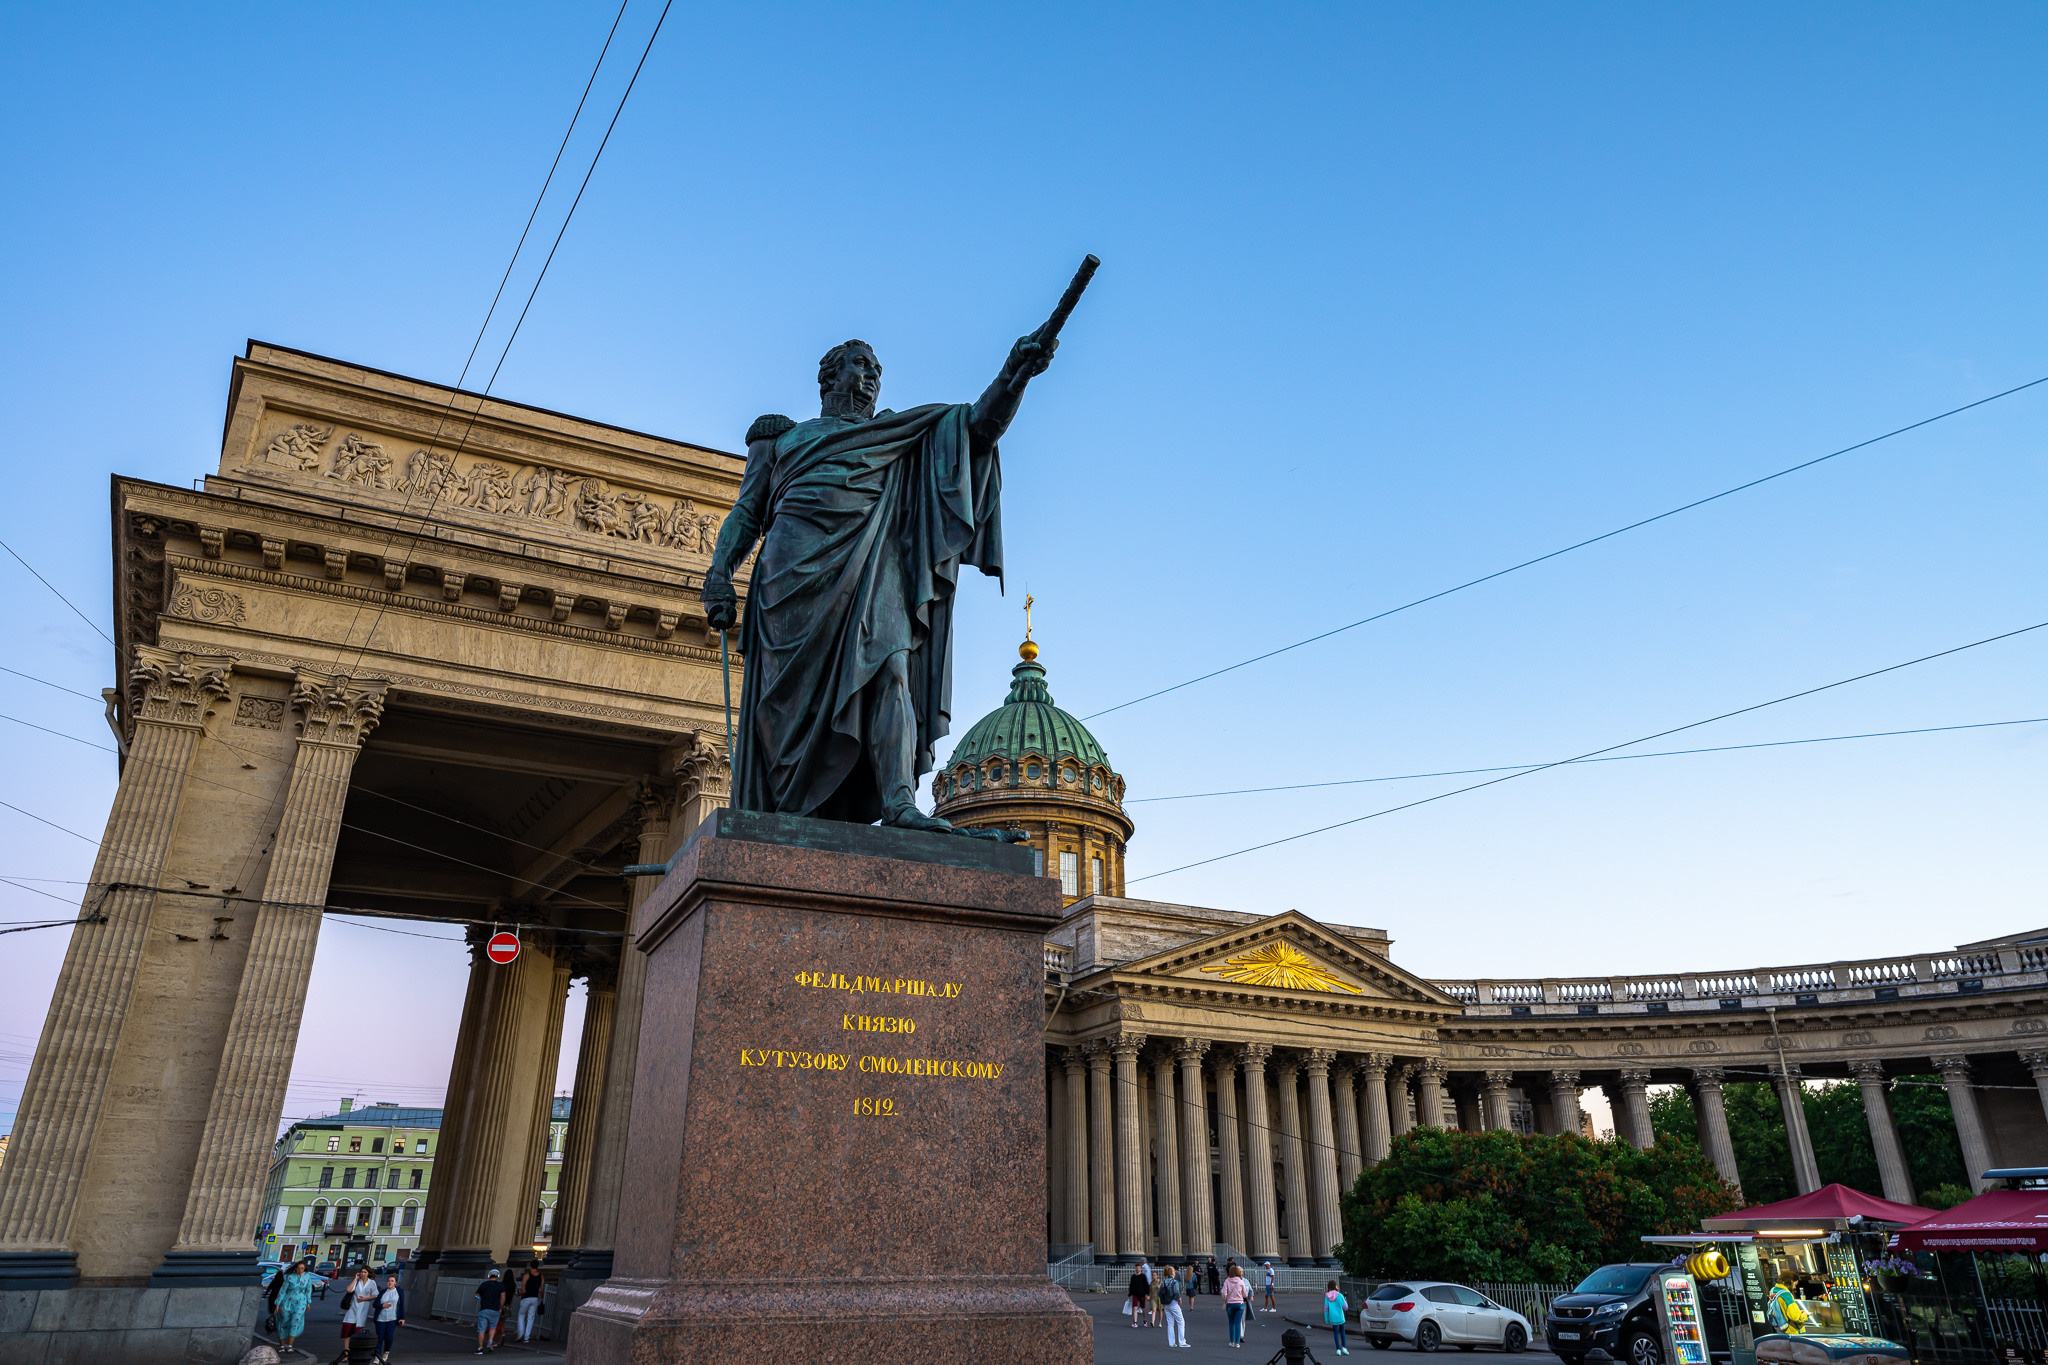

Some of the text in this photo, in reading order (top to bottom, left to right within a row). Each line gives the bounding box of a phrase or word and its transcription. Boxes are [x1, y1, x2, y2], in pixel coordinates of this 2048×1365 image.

[794, 970, 964, 999] ФЕЛЬДМАРШАЛУ
[842, 1013, 916, 1034] КНЯЗЮ
[740, 1048, 1005, 1079] КУТУЗОВУ СМОЛЕНСКОМУ
